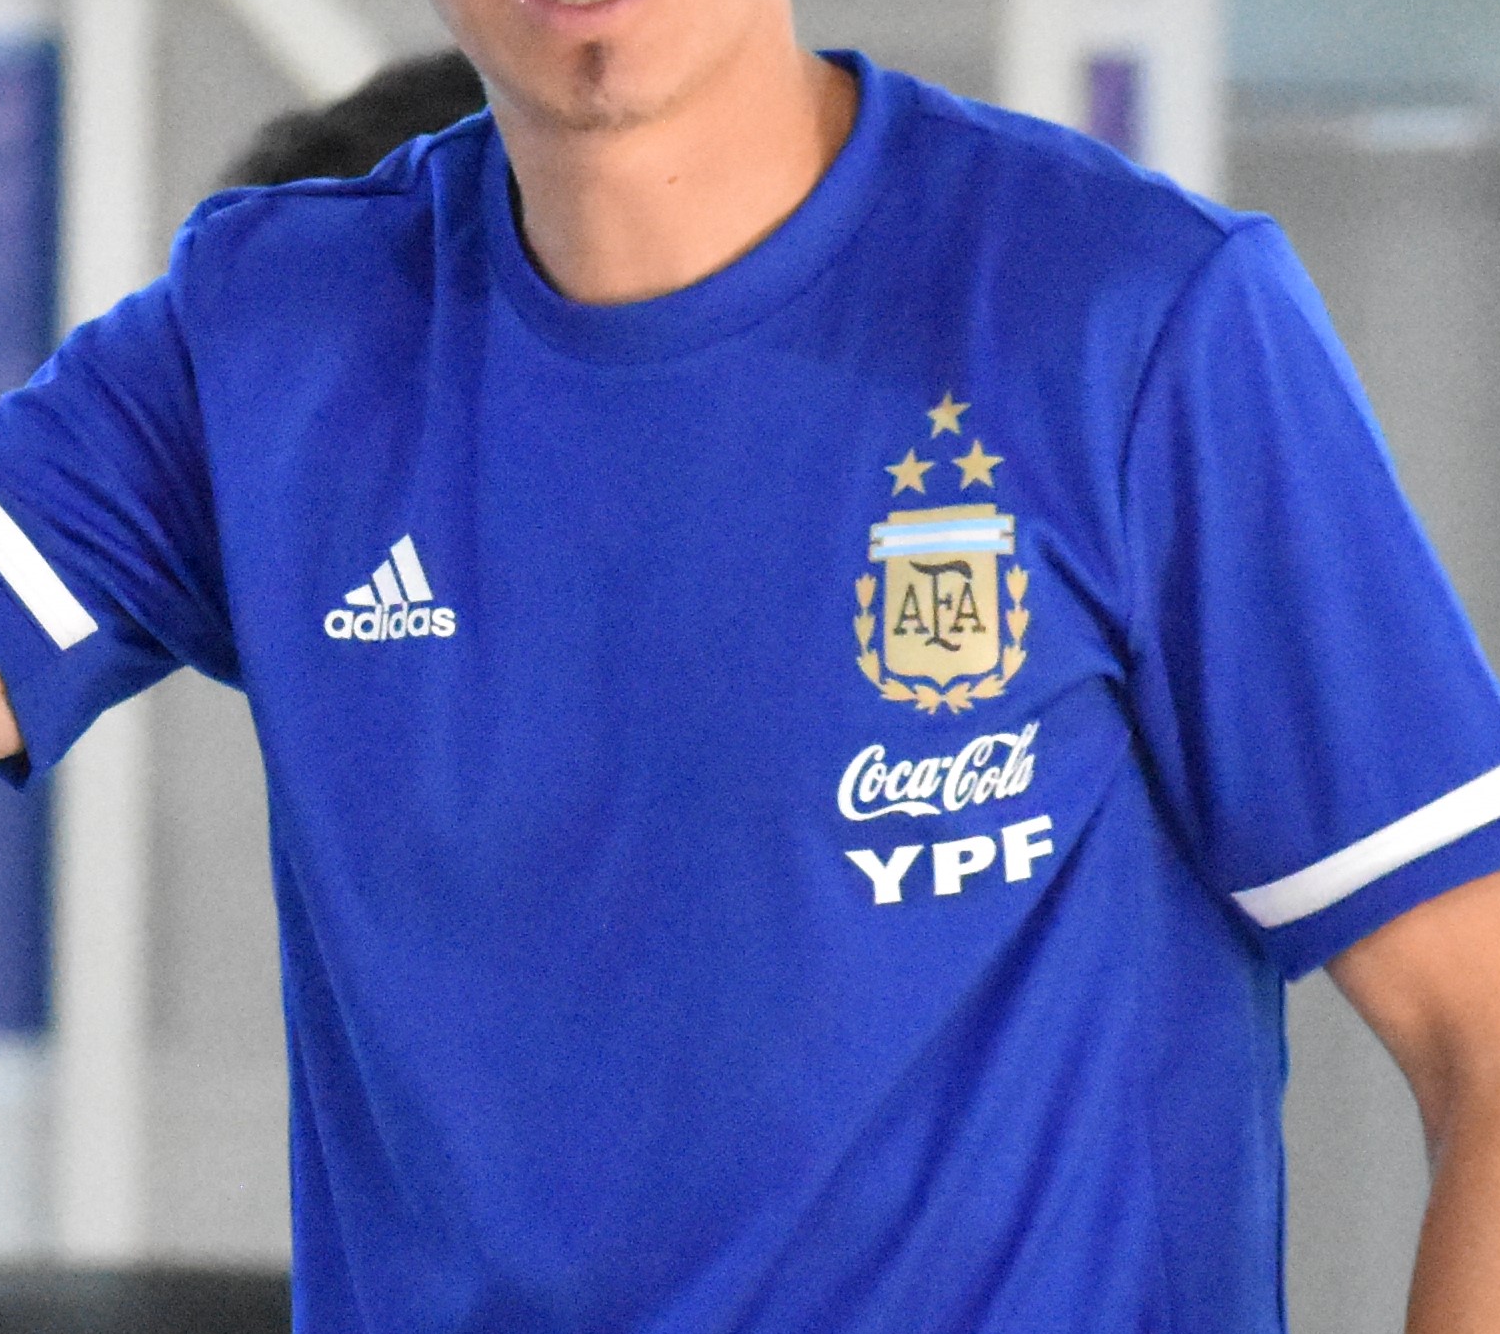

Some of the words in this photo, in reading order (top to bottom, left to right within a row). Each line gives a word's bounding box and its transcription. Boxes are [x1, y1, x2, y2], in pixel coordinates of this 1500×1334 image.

[324, 602, 457, 642] adidas
[894, 559, 987, 652] AFA
[837, 720, 1040, 821] Coca-Cola
[844, 814, 1053, 905] YPF
